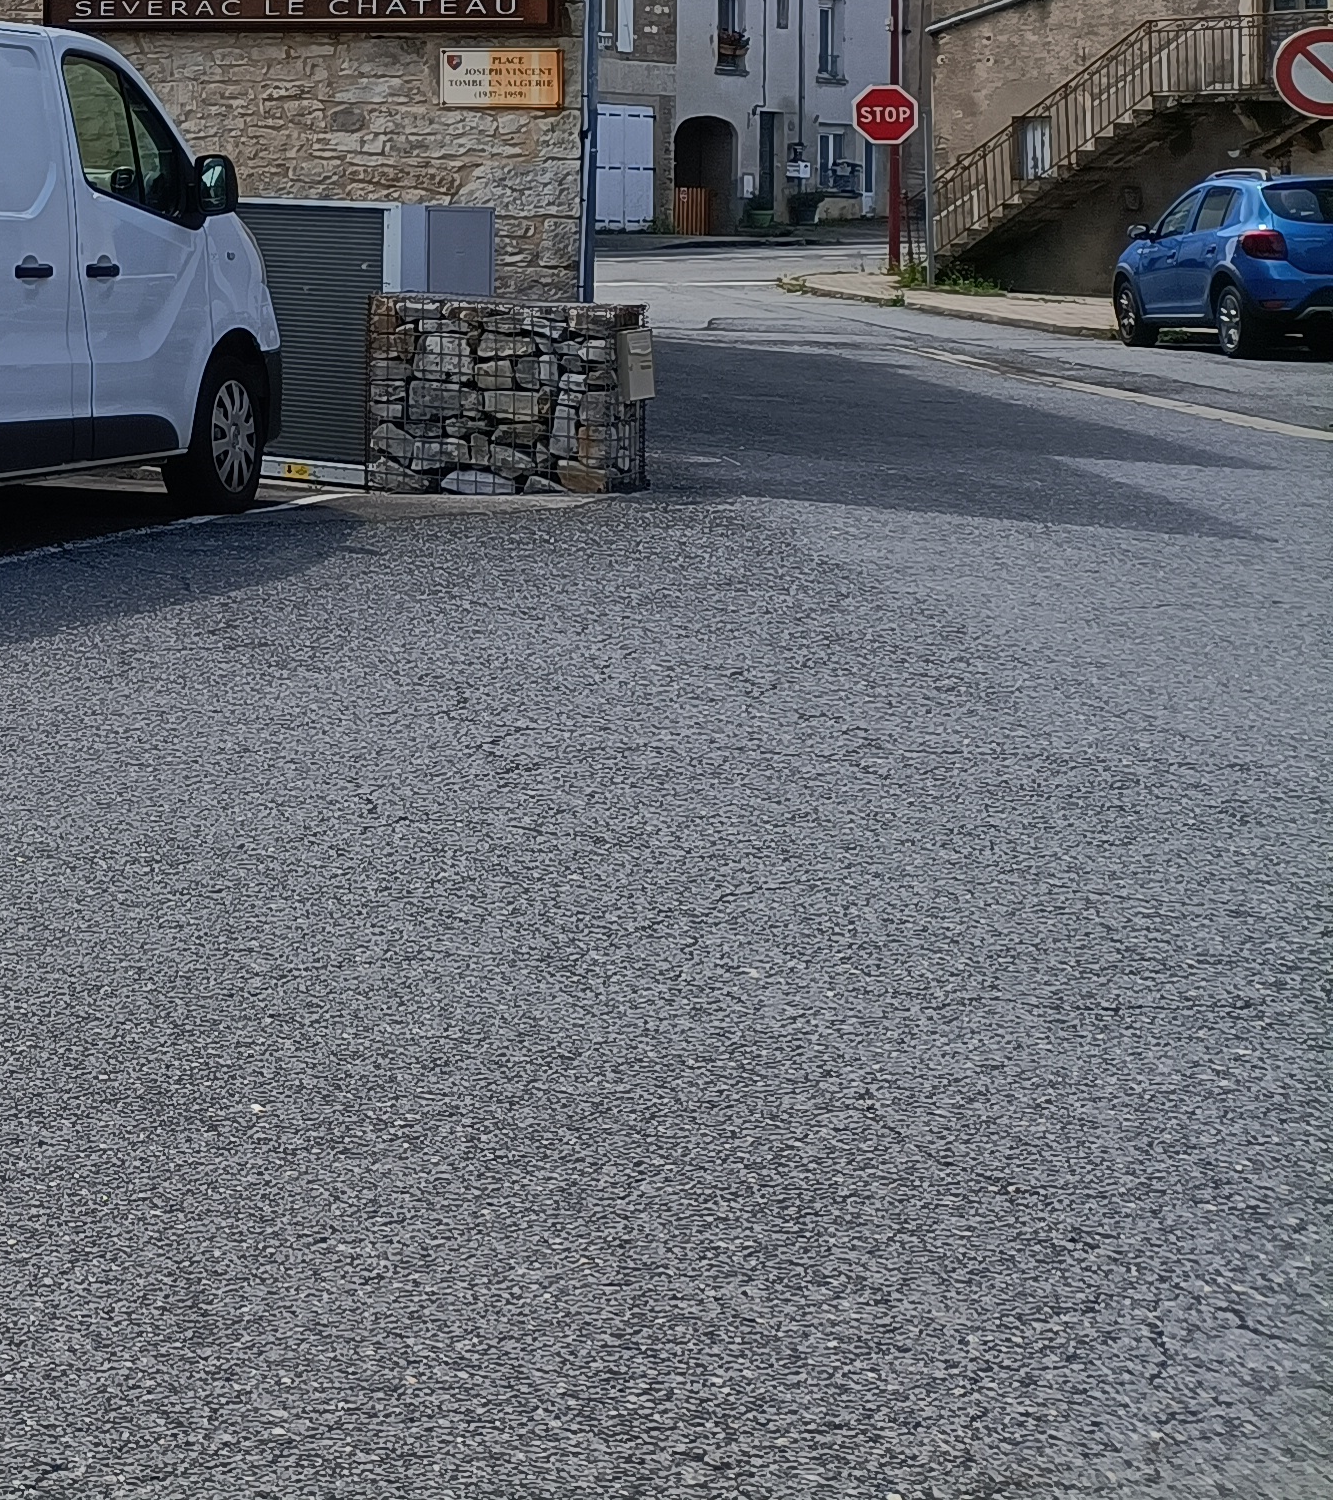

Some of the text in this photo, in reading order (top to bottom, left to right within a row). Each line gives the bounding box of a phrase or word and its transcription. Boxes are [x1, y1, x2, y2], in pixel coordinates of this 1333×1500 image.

[75, 0, 242, 17] SEVERAC
[491, 56, 525, 65] PLACE
[464, 67, 553, 76] JOSEPH VINCENT
[860, 106, 911, 123] STOP
